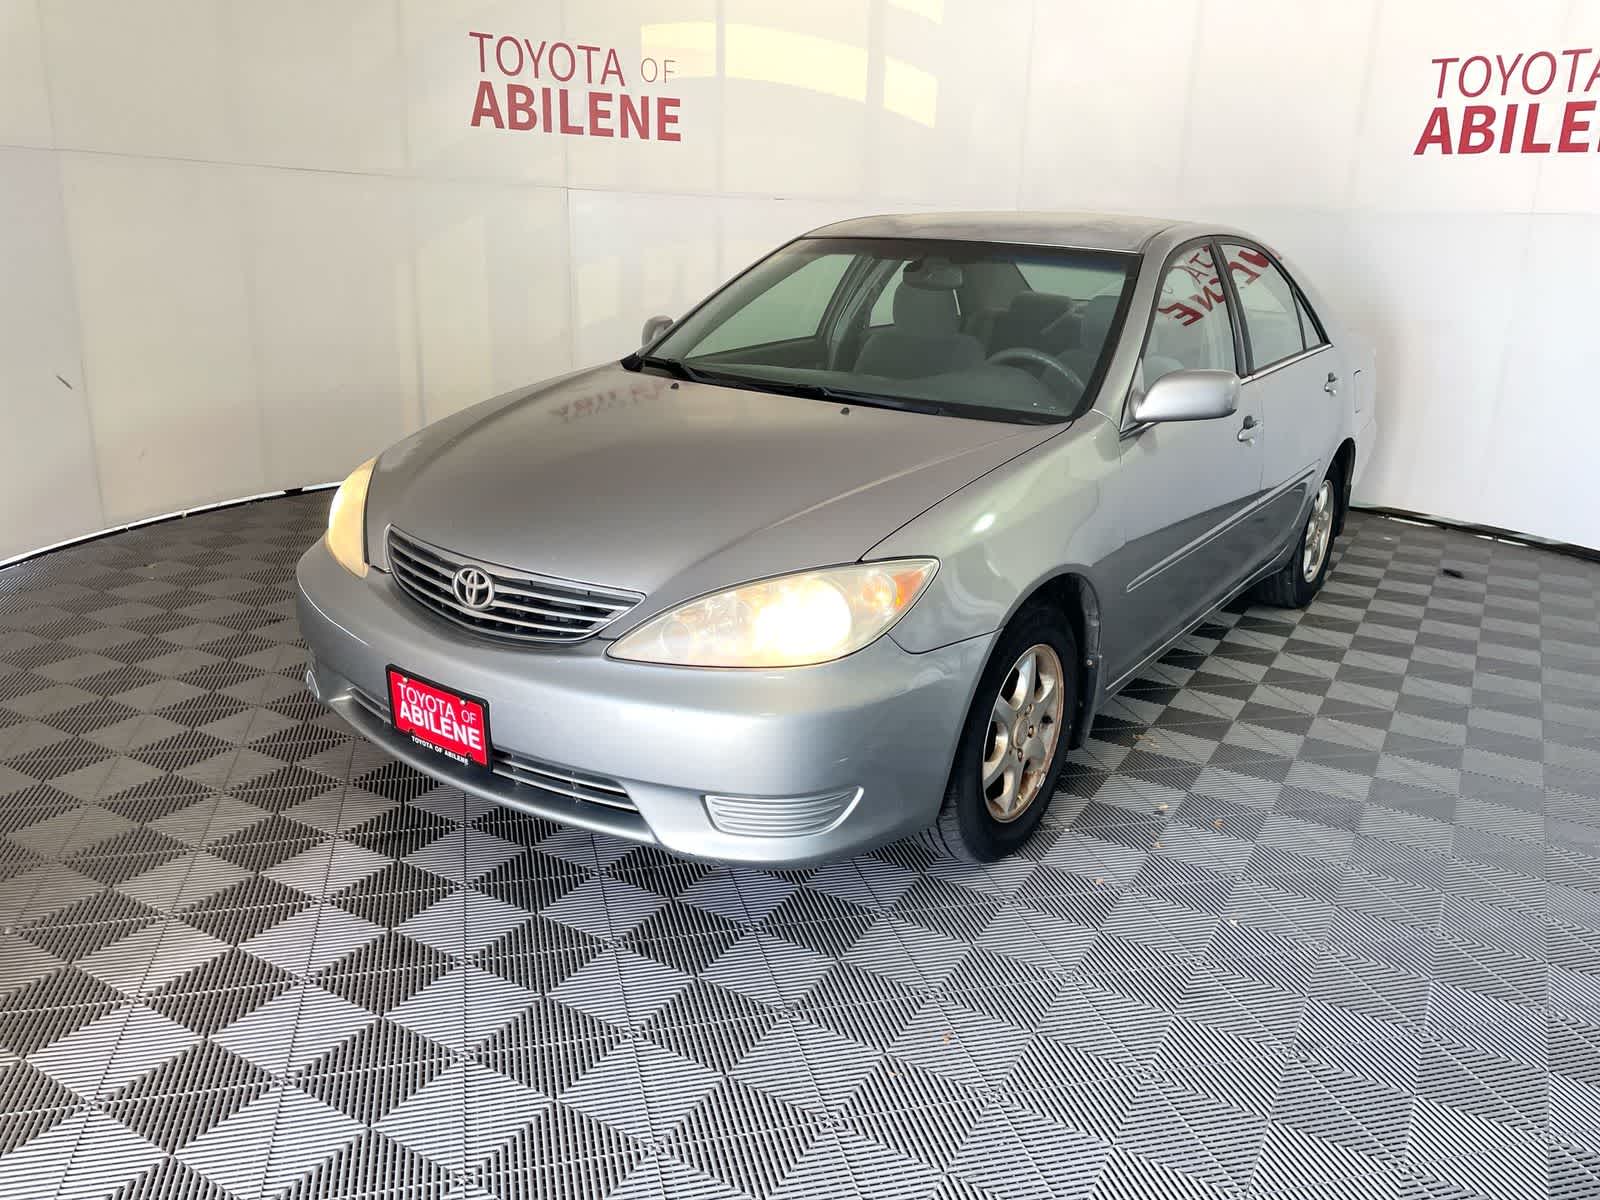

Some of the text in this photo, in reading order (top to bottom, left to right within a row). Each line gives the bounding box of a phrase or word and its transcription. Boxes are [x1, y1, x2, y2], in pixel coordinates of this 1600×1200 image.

[469, 31, 676, 87] TOYOTA OF
[470, 80, 682, 142] ABILENE
[1413, 100, 1600, 156] ABILE
[397, 682, 477, 724] TOYOTA OF
[400, 700, 482, 751] ABILENE
[411, 735, 433, 750] TOYOTA
